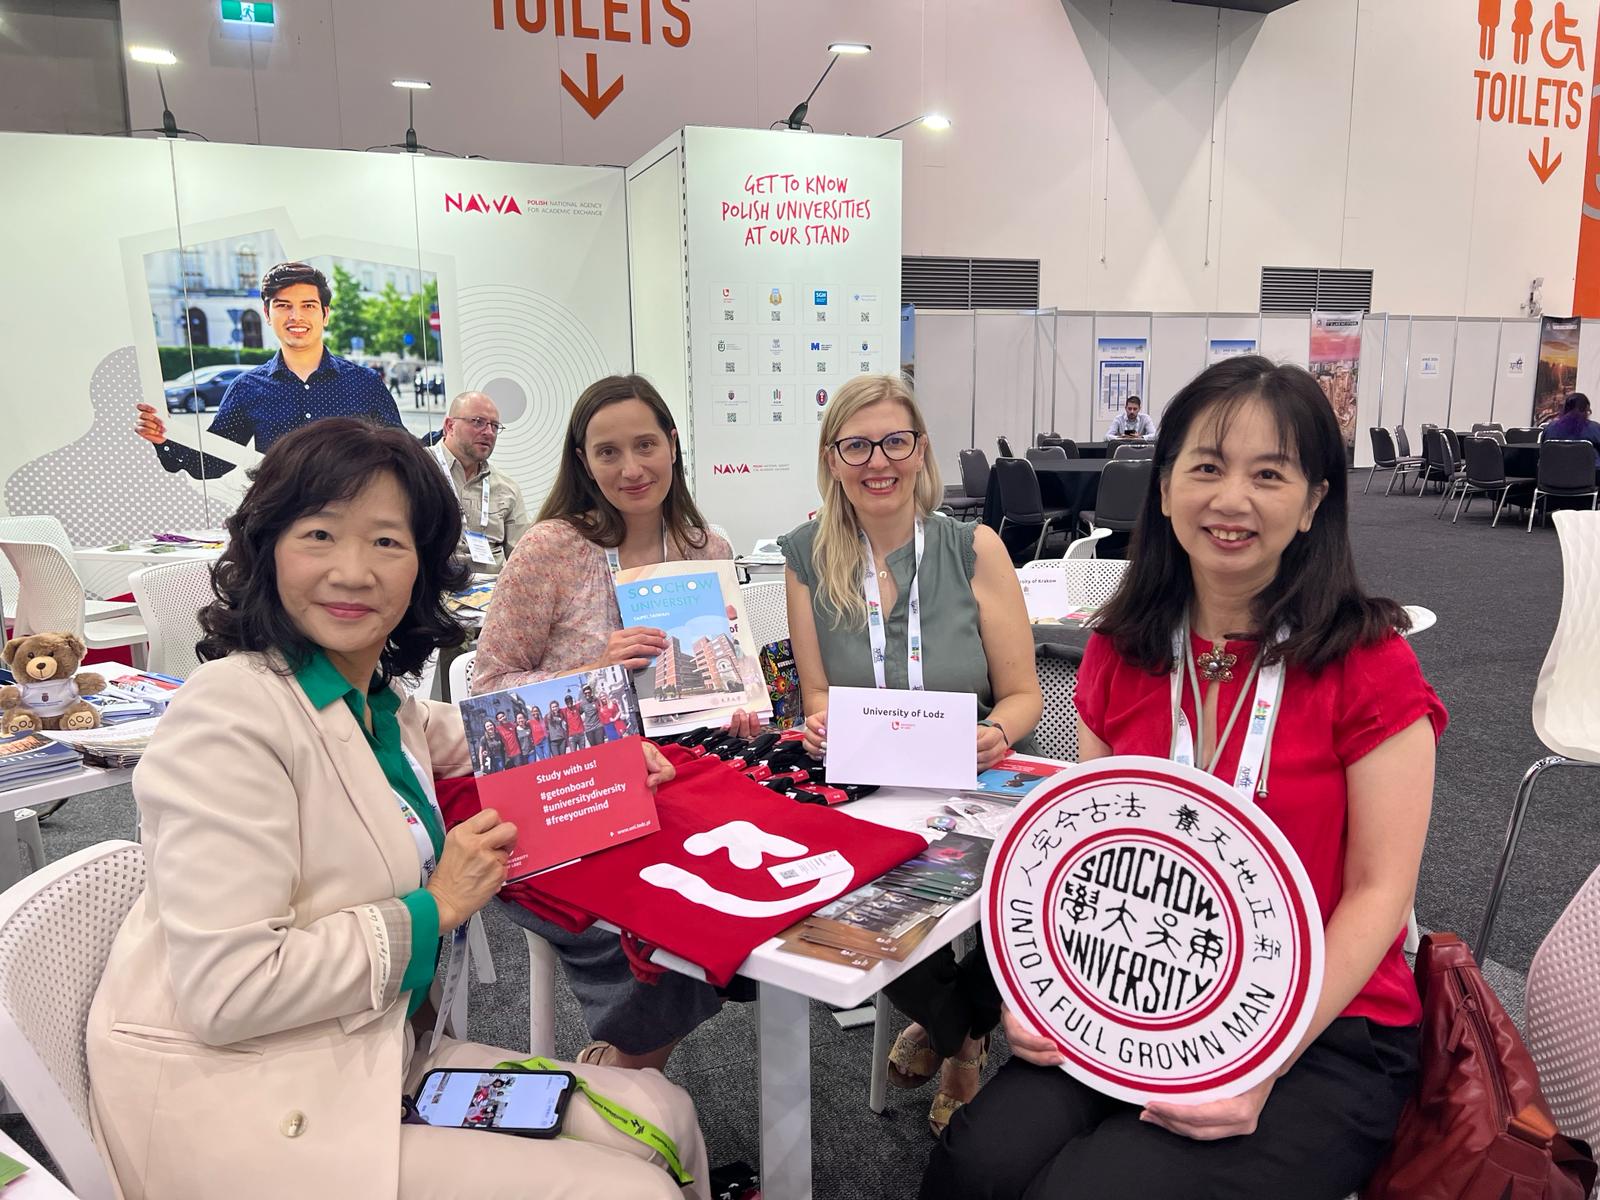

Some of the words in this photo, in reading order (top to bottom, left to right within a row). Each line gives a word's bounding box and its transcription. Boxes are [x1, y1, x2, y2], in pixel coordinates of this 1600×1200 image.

[1474, 69, 1584, 130] TOILETS
[744, 174, 779, 195] GET
[780, 174, 800, 194] TO
[806, 174, 848, 196] KNOW
[445, 192, 523, 215] NAWA
[721, 200, 769, 221] POLISH
[776, 199, 871, 221] UNIVERSITIES
[744, 225, 767, 247] AT
[770, 227, 801, 246] OUR
[805, 224, 850, 246] STAND
[713, 463, 751, 475] NAWA
[627, 578, 715, 600] SOOCHOW
[630, 594, 701, 613] UNIVERSITY
[862, 707, 909, 719] University
[911, 709, 921, 718] of
[923, 710, 945, 719] Lodz
[536, 769, 561, 784] Study
[563, 764, 583, 777] with
[584, 760, 597, 771] us!
[540, 777, 595, 801] #getonboard
[543, 783, 627, 813] #universitydiversity
[545, 800, 609, 826] #freeyourmind
[1072, 847, 1220, 922] SOOCHOW
[1010, 899, 1043, 970] UNTO
[1030, 976, 1055, 998] A
[1050, 995, 1107, 1055] FULL
[1119, 1030, 1226, 1071] GROWN
[1221, 982, 1276, 1044] MAN
